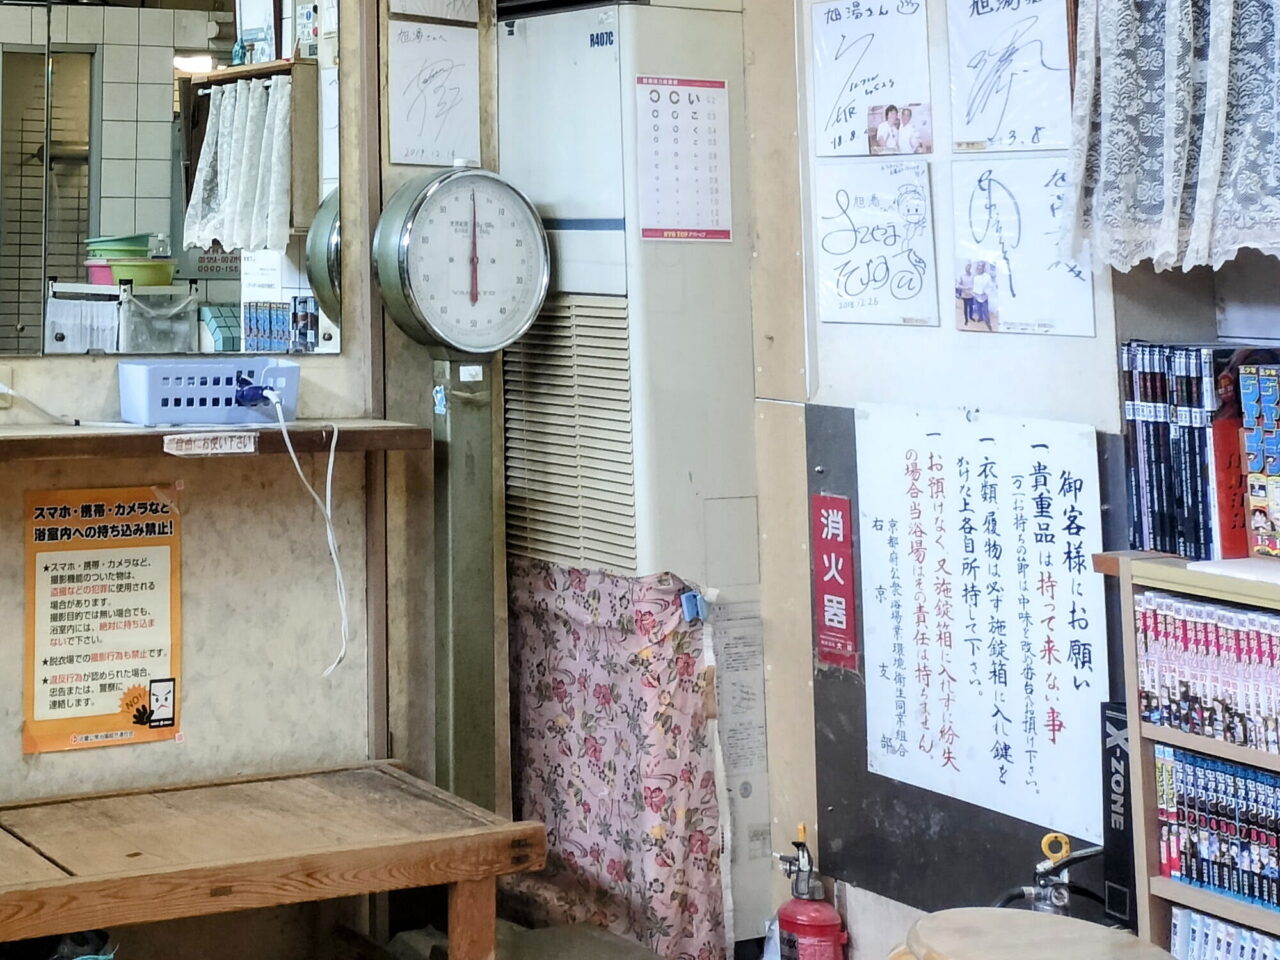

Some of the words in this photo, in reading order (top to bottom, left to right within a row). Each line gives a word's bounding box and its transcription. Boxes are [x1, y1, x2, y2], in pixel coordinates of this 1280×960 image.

[589, 31, 614, 48] R407C
[820, 508, 847, 630] 消火器
[1058, 470, 1093, 691] 御客様にお願い
[50, 597, 111, 610] 場合があります。
[50, 635, 103, 647] ないで下さい。
[49, 698, 95, 710] 連絡します。
[1106, 720, 1129, 831] X-ZONE
